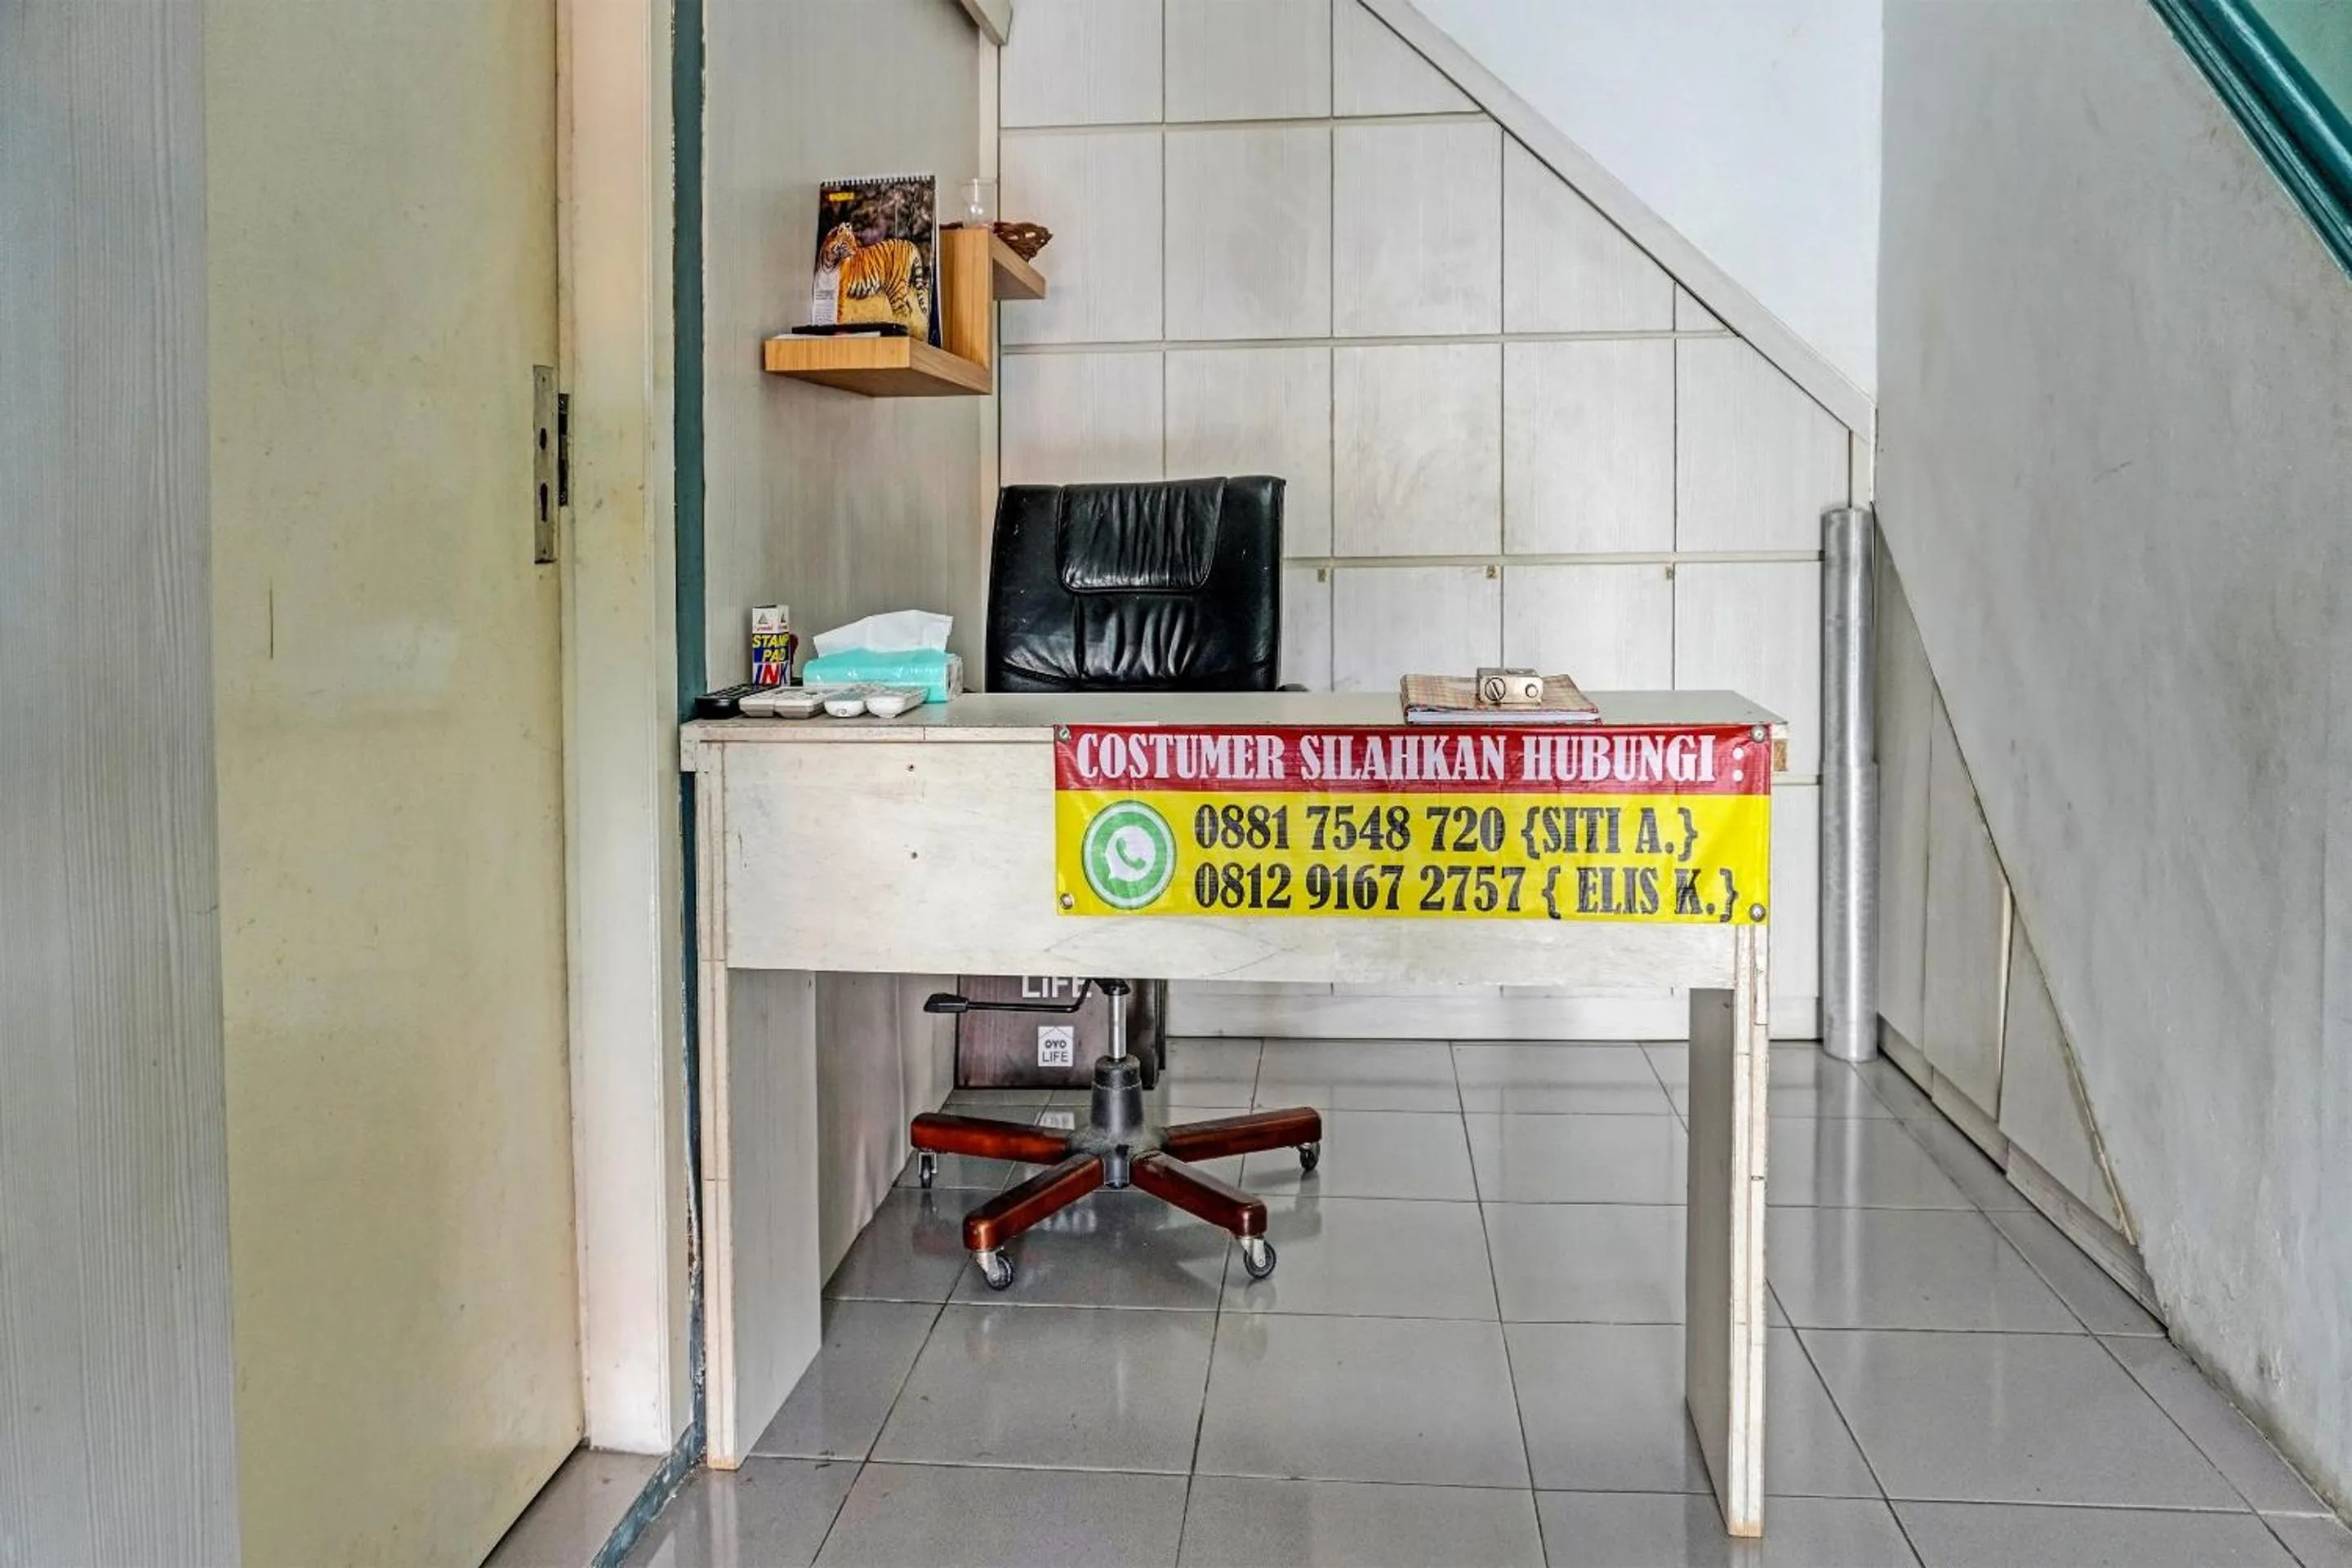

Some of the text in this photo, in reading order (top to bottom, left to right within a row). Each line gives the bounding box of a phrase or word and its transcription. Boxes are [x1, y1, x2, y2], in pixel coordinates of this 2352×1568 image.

[763, 648, 786, 662] PAD
[1076, 733, 1285, 781] COSTUMER
[1299, 734, 1506, 782] SILAHKAN
[1521, 734, 1716, 782] HUBUNGI
[1194, 804, 1699, 862] 0881 7548 720 {SITI A.}
[1194, 862, 1292, 909] 0812
[1305, 864, 1405, 911] 9167
[1419, 865, 1526, 912] 2757
[1575, 866, 1661, 915] ELIS
[1674, 868, 1740, 923] K.}
[1042, 1051, 1068, 1062] LIFE
[1045, 1039, 1067, 1049] OYO
